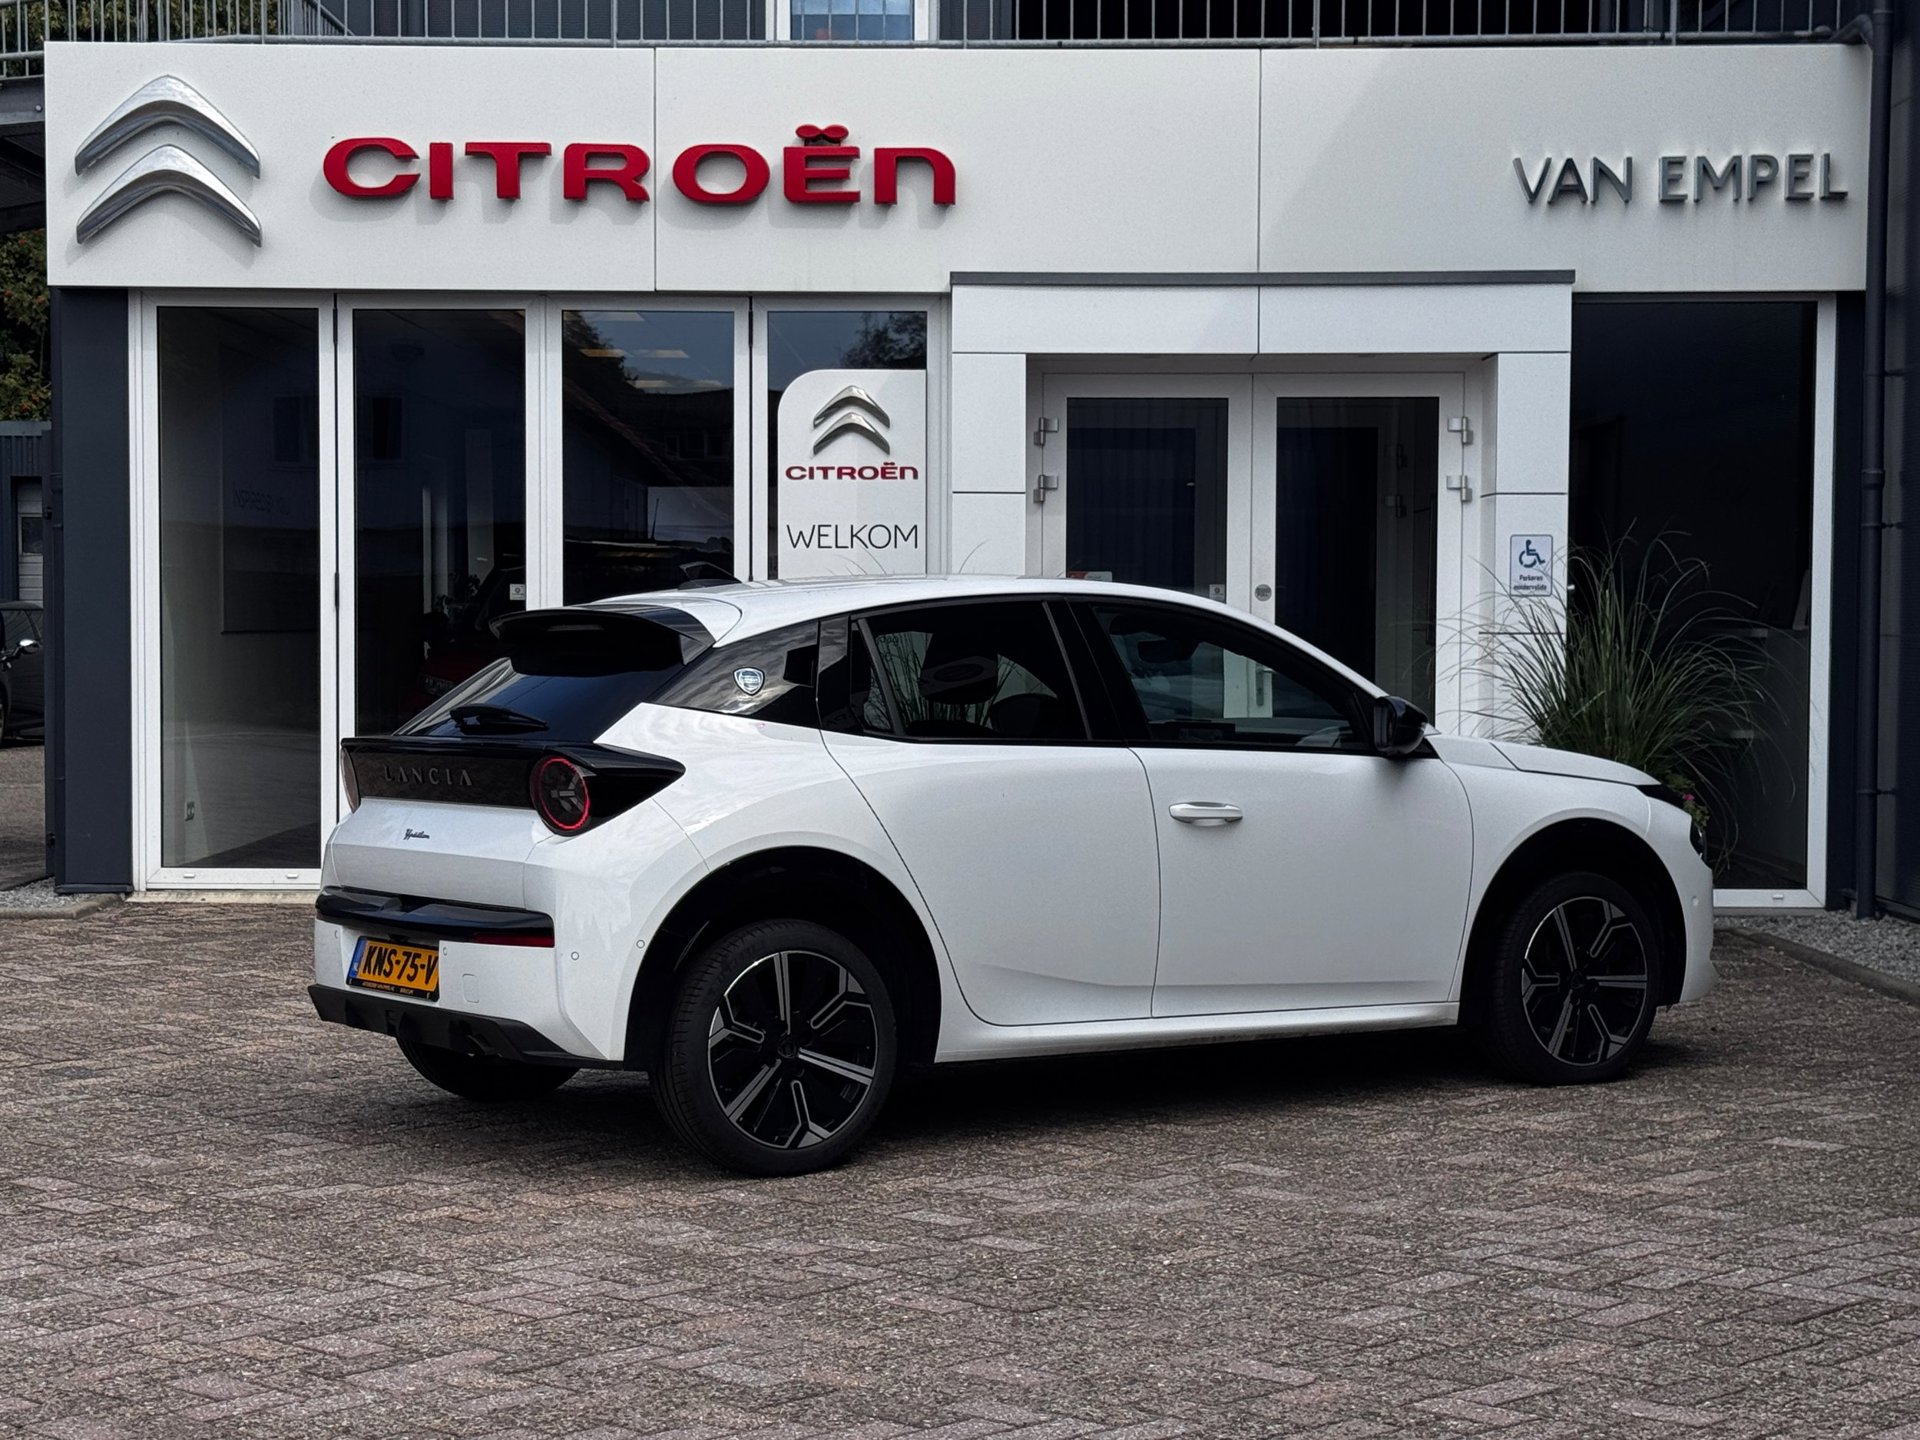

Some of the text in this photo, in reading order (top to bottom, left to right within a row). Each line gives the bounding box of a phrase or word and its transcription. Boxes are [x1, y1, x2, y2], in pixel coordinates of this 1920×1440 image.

[323, 124, 956, 205] CITROËN
[1512, 153, 1849, 204] VAN EMPEL
[785, 461, 919, 481] CITROËN
[786, 524, 919, 550] WELKOM
[384, 765, 473, 786] LANCIA
[363, 945, 439, 985] KNS-75-V
